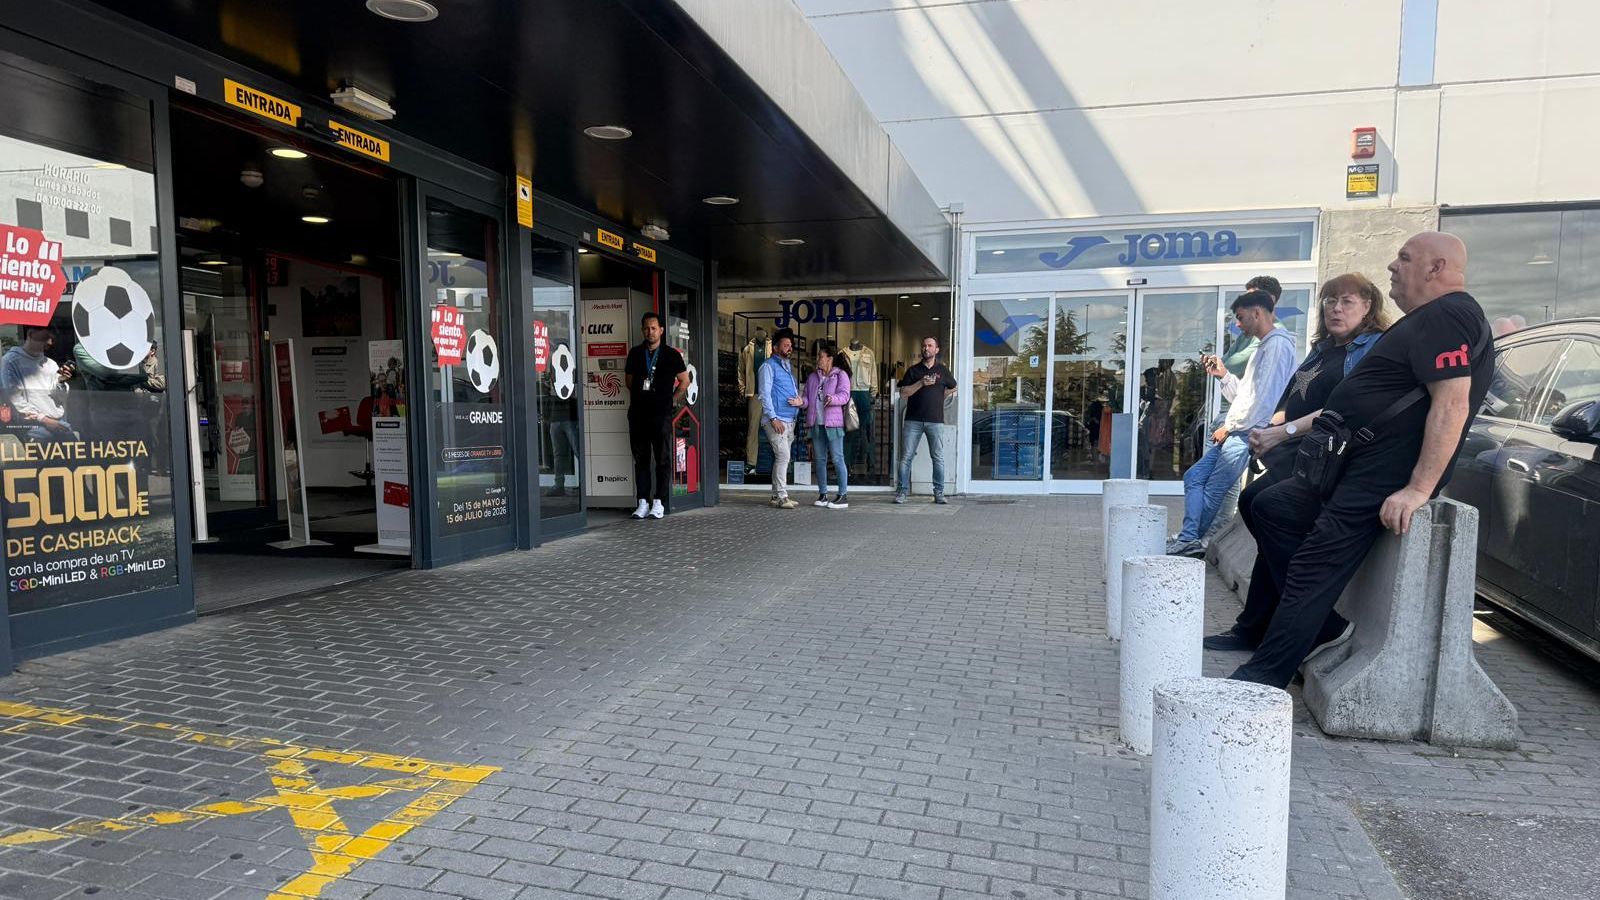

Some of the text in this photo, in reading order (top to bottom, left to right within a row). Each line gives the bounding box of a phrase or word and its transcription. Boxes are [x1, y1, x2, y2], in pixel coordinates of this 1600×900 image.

[236, 87, 291, 121] ENTRADA
[337, 128, 382, 156] ENTRADA
[44, 163, 89, 184] HORARIO
[6, 232, 29, 255] Lo
[601, 232, 621, 247] ENTRADA
[0, 254, 56, 283] iento,
[20, 278, 44, 297] hay
[444, 309, 453, 323] Lo
[439, 323, 463, 339] siento,
[588, 323, 614, 335] CLICK
[439, 346, 461, 358] Mundial
[469, 411, 503, 424] GRANDE
[1, 438, 148, 462] LLÉVATE HASTA
[453, 496, 507, 512] Del 15 de MAYO al
[446, 506, 507, 523] 15 de JULIO de 2026
[7, 525, 142, 558] DE CASHBACK
[9, 549, 135, 576] con la compra de un TV
[90, 568, 98, 580] &
